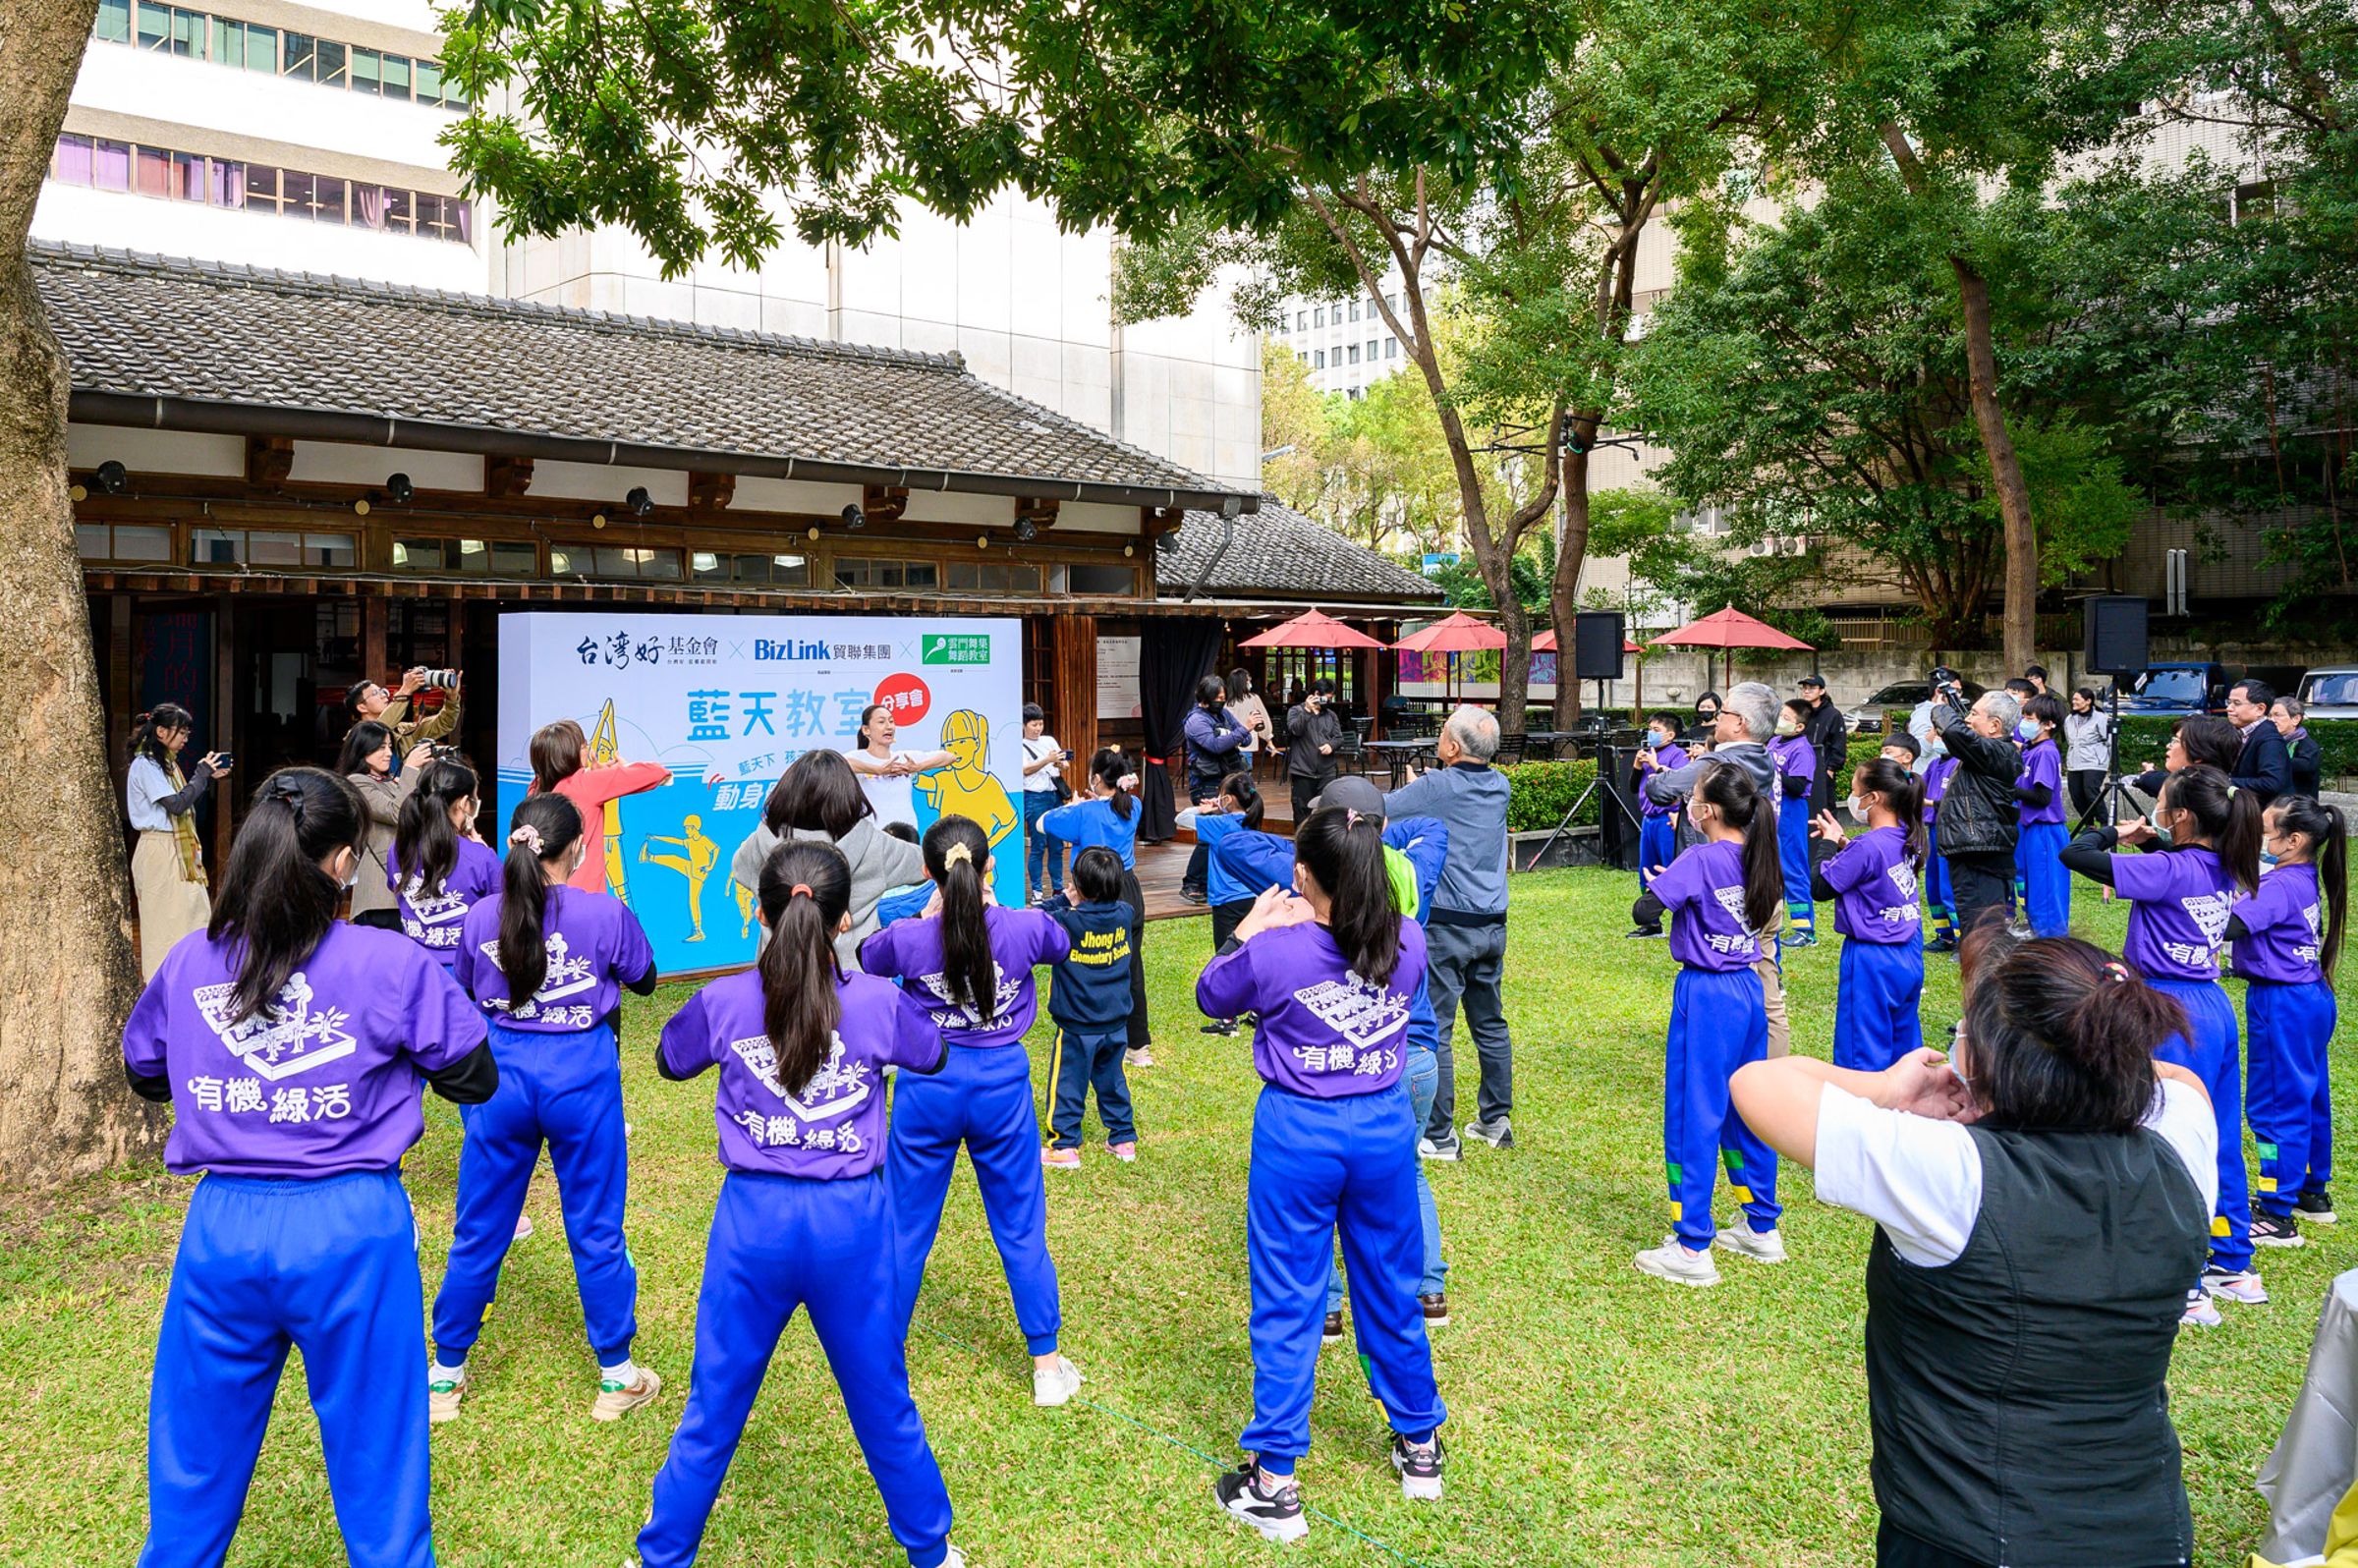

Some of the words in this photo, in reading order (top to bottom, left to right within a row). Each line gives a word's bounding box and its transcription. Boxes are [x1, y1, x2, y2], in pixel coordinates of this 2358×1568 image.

[667, 636, 718, 656] 基金會
[754, 639, 831, 660] BizLink
[832, 644, 891, 660] 貿聯集團
[880, 688, 925, 713] 分享會
[687, 688, 872, 741] 藍天教室
[738, 753, 775, 776] 藍天下
[712, 780, 778, 812] 動身
[1879, 902, 1920, 922] 有機
[401, 918, 462, 946] 機綠活
[1081, 930, 1114, 950] Jhong
[2162, 941, 2213, 969] 有機
[188, 1075, 351, 1124] 有機綠活
[733, 1110, 862, 1153] 有機綠活
